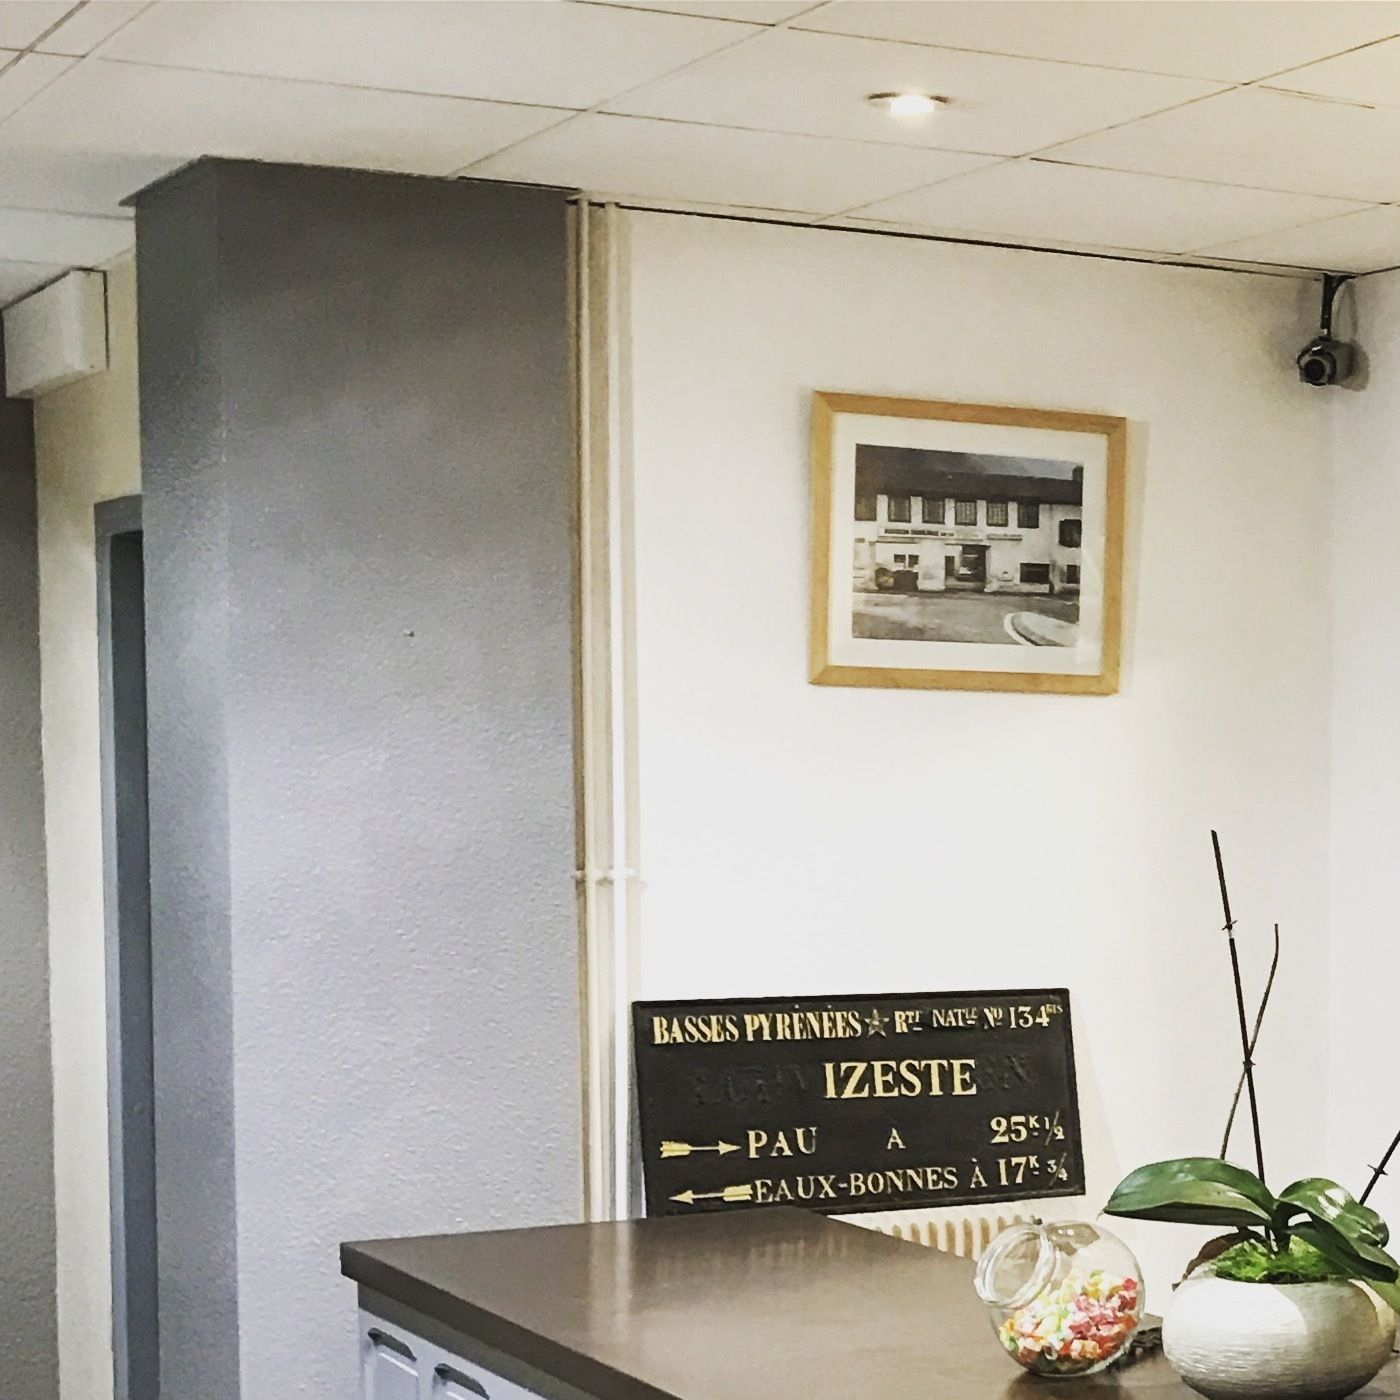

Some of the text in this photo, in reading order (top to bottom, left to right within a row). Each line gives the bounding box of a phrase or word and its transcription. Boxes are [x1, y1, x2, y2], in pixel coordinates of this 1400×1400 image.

[652, 1015, 739, 1044] BASSES
[823, 1059, 977, 1099] IZESTE
[747, 1127, 817, 1158] PAU
[755, 1167, 958, 1203] EAUX-BONNES
